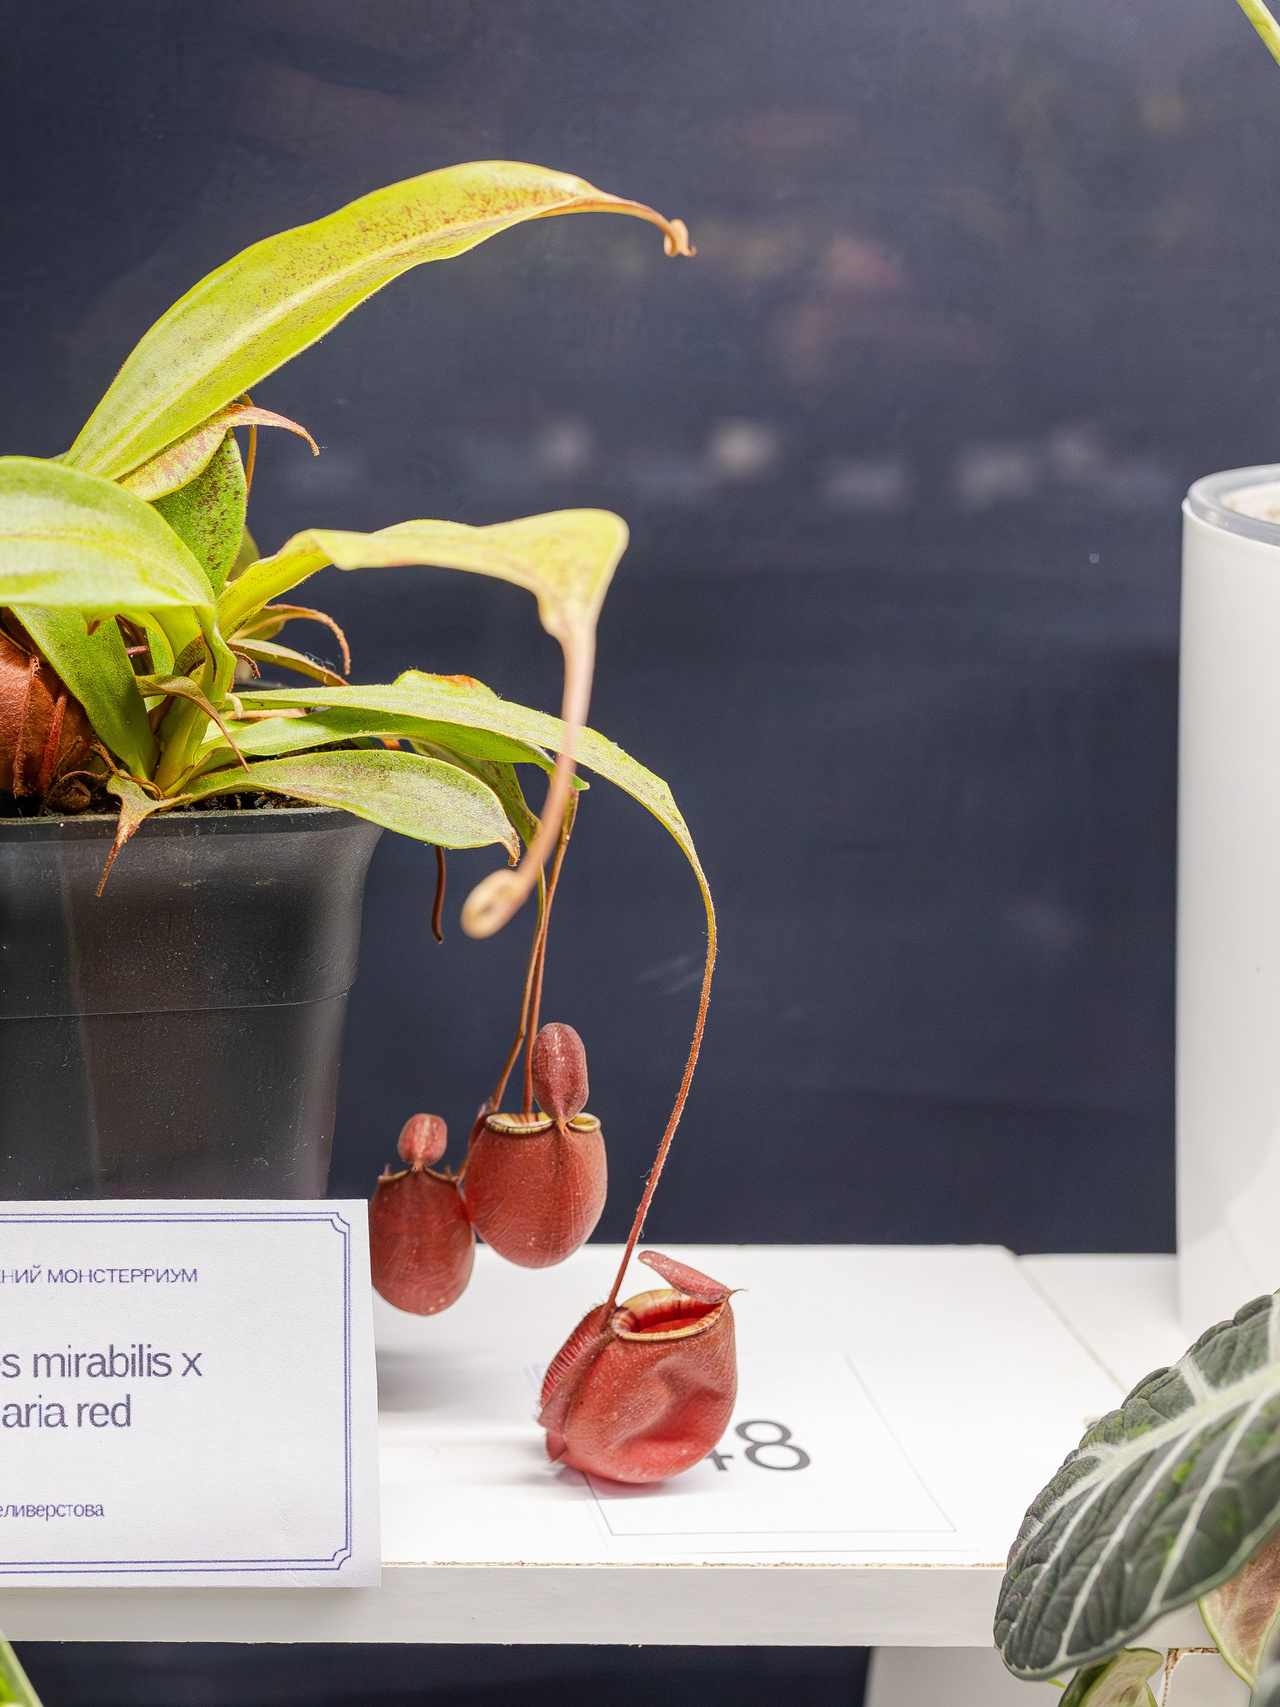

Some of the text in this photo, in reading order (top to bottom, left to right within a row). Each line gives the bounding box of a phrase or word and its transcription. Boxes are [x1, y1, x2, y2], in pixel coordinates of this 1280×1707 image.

[47, 1268, 198, 1284] МОНСТЕРРИУМ
[32, 1343, 173, 1379] mirabilis
[181, 1352, 203, 1377] x
[76, 1393, 131, 1428] red
